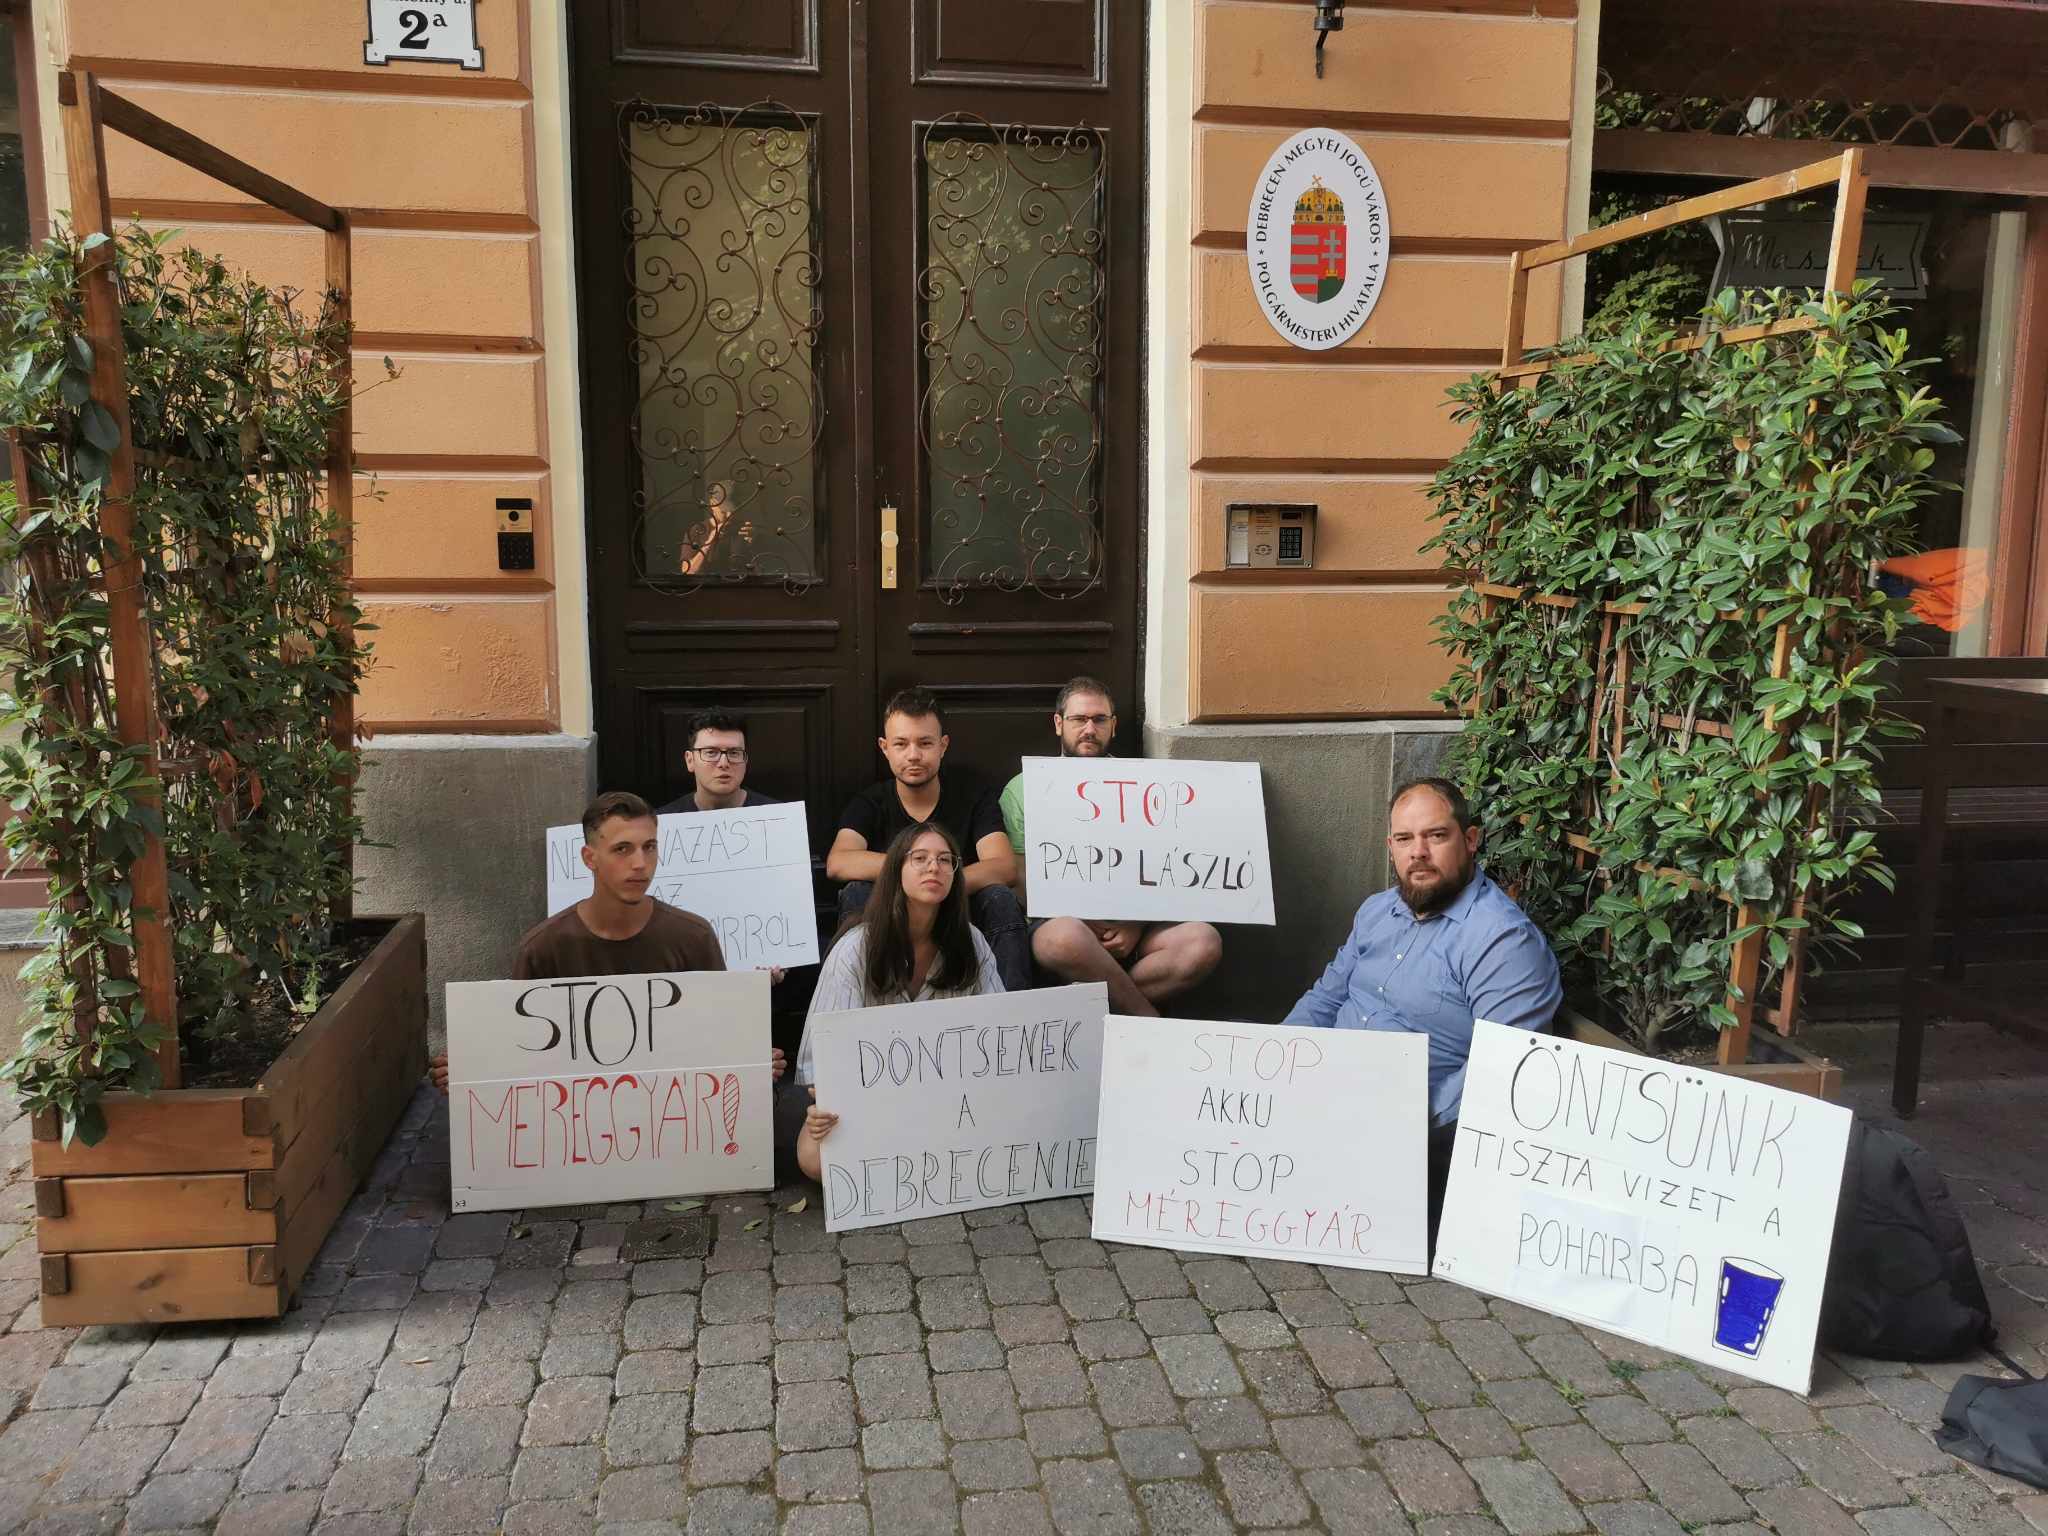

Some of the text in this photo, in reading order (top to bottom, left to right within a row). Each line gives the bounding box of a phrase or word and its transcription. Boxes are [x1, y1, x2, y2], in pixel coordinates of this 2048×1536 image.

[1256, 137, 1381, 244] DEBRECEN MEGYEI JOGÚ VÁROS
[1257, 261, 1379, 342] POLGÁRMESTERI HIVATALA
[1072, 780, 1196, 829] STOP
[1039, 842, 1255, 890] PAPP LÁSZLÓ
[515, 978, 683, 1066] STOP
[859, 1017, 1082, 1088] DÖNTSENEK
[1189, 1033, 1323, 1085] STOP
[957, 1093, 976, 1128] A
[1197, 1086, 1273, 1128] AKKU
[1510, 1037, 1797, 1189] ÖNTSÜNK
[828, 1137, 1098, 1221] DEBRECENIE
[1179, 1150, 1295, 1194] STOP
[1462, 1126, 1781, 1236] TISZTA VIZET A
[1126, 1189, 1372, 1254] MÉREGGYÁR
[1517, 1212, 1699, 1306] POHÁRBA
